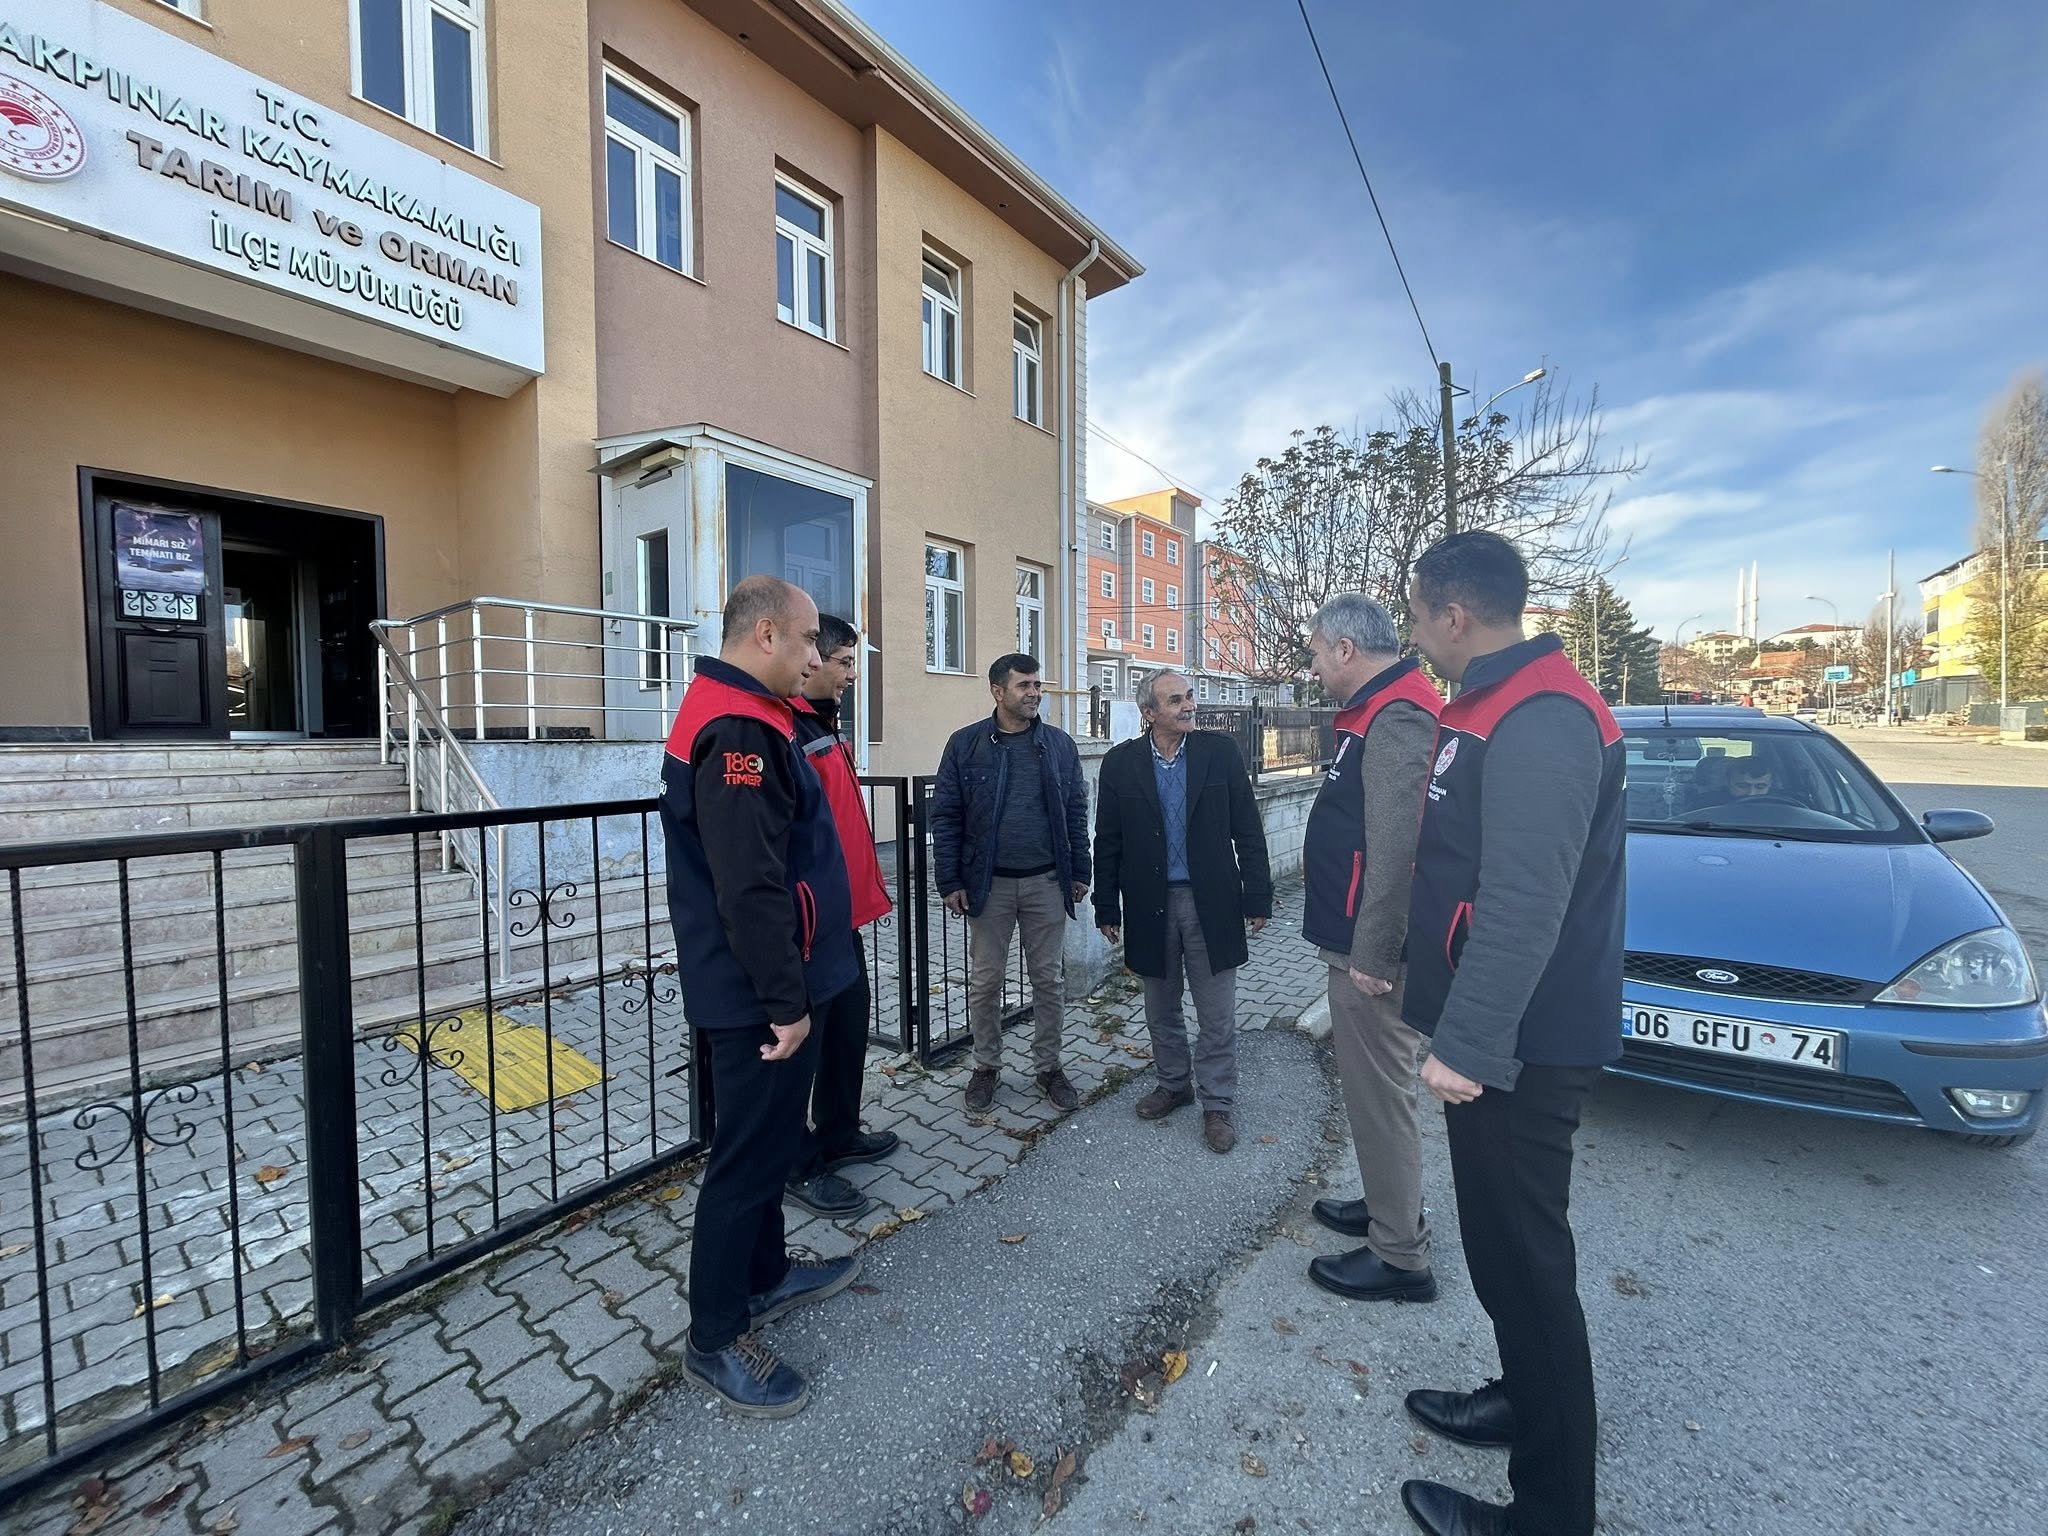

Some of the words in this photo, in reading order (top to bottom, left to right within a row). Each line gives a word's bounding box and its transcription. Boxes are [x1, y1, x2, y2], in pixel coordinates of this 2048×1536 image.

[0, 22, 230, 149] AKPINAR
[243, 126, 521, 266] KAYMAKAMLIĞI
[257, 89, 331, 148] T.C.
[126, 130, 293, 222] TARIM
[313, 208, 363, 247] ve
[379, 231, 518, 306] ORMAN
[211, 210, 280, 271] İLÇE
[289, 248, 463, 331] MÜDÜRLÜĞÜ
[1635, 1010, 1669, 1038] 06
[1692, 1019, 1750, 1051] GFU
[1791, 1032, 1832, 1064] 74
